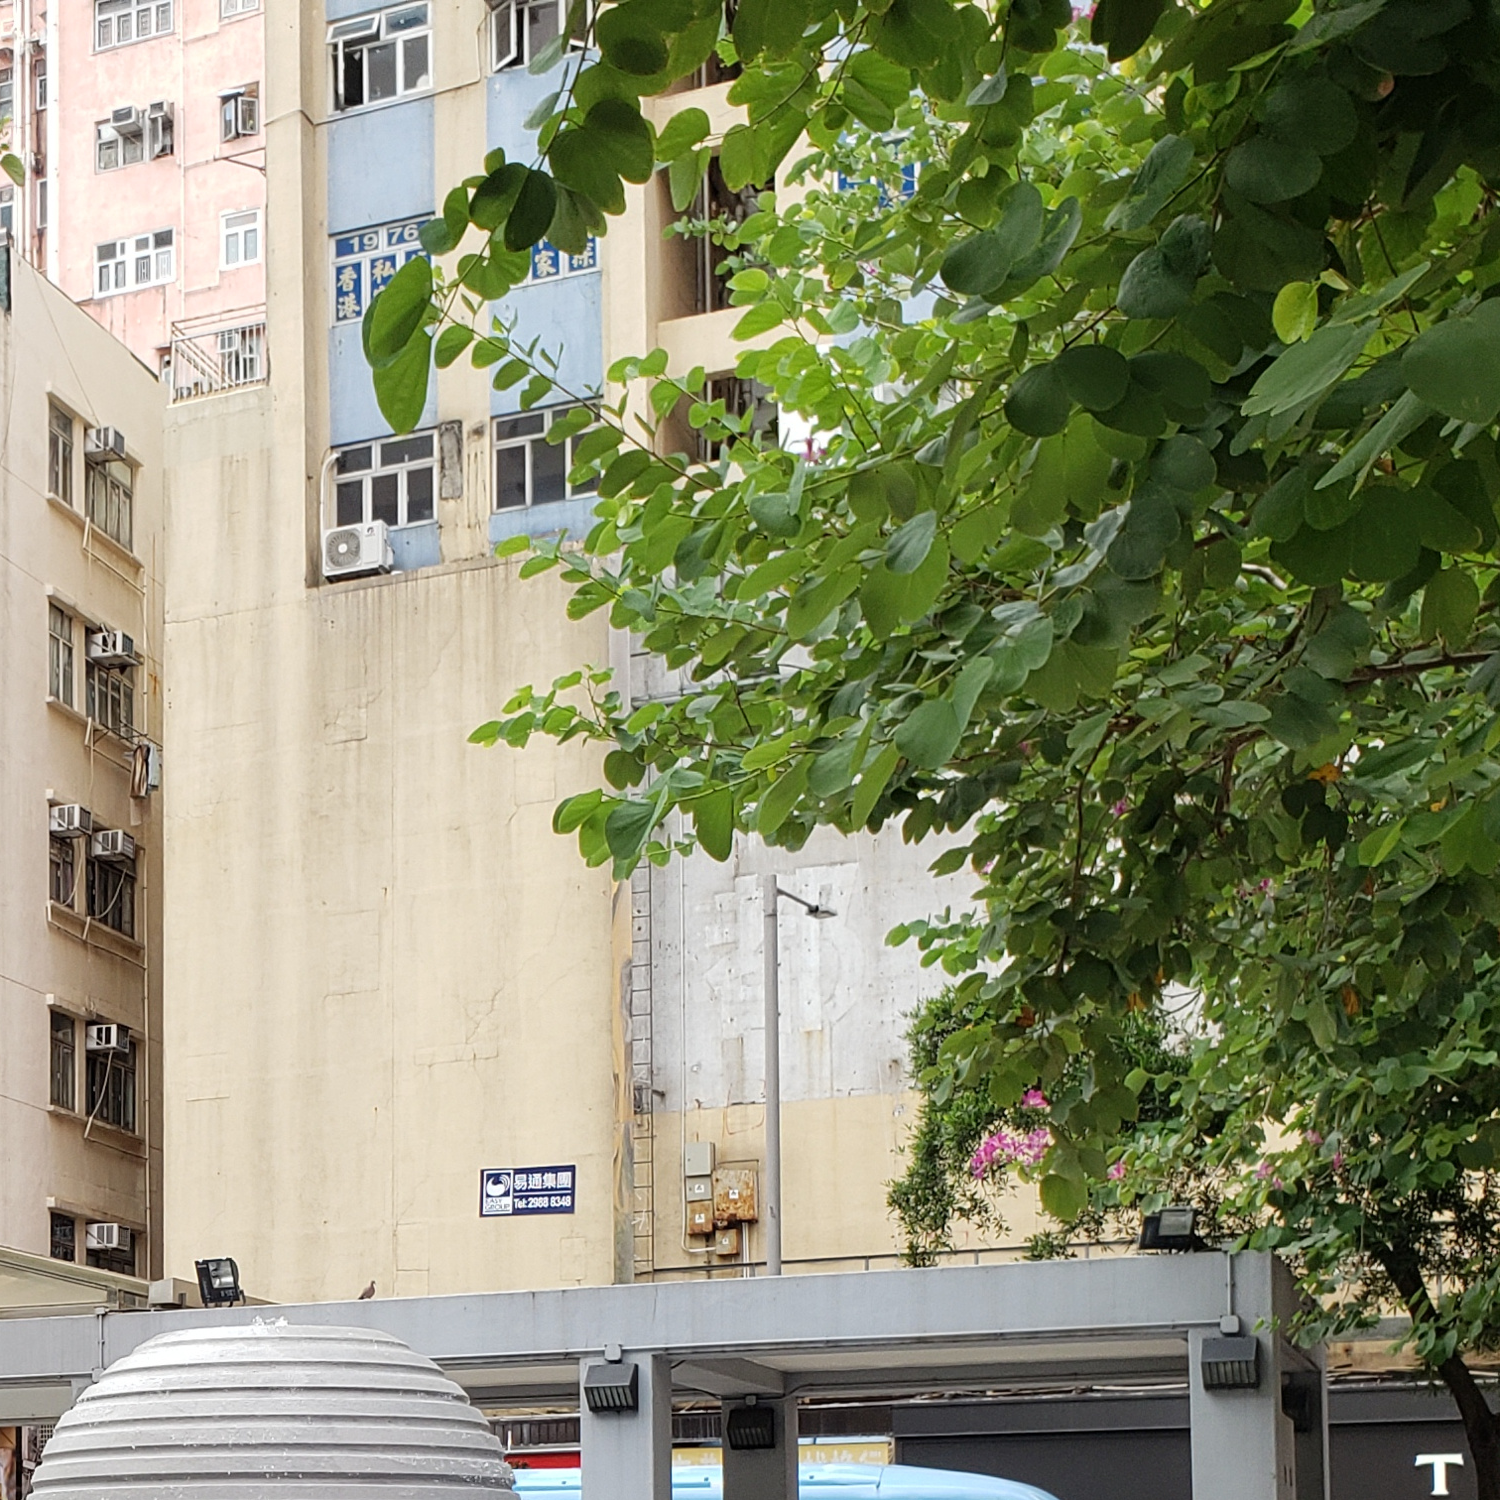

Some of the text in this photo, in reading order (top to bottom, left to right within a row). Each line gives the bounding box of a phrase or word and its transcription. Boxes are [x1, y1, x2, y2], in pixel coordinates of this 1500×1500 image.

[337, 266, 361, 319] 香港
[514, 1172, 572, 1190] 易通集團
[1414, 1452, 1465, 1496] T
